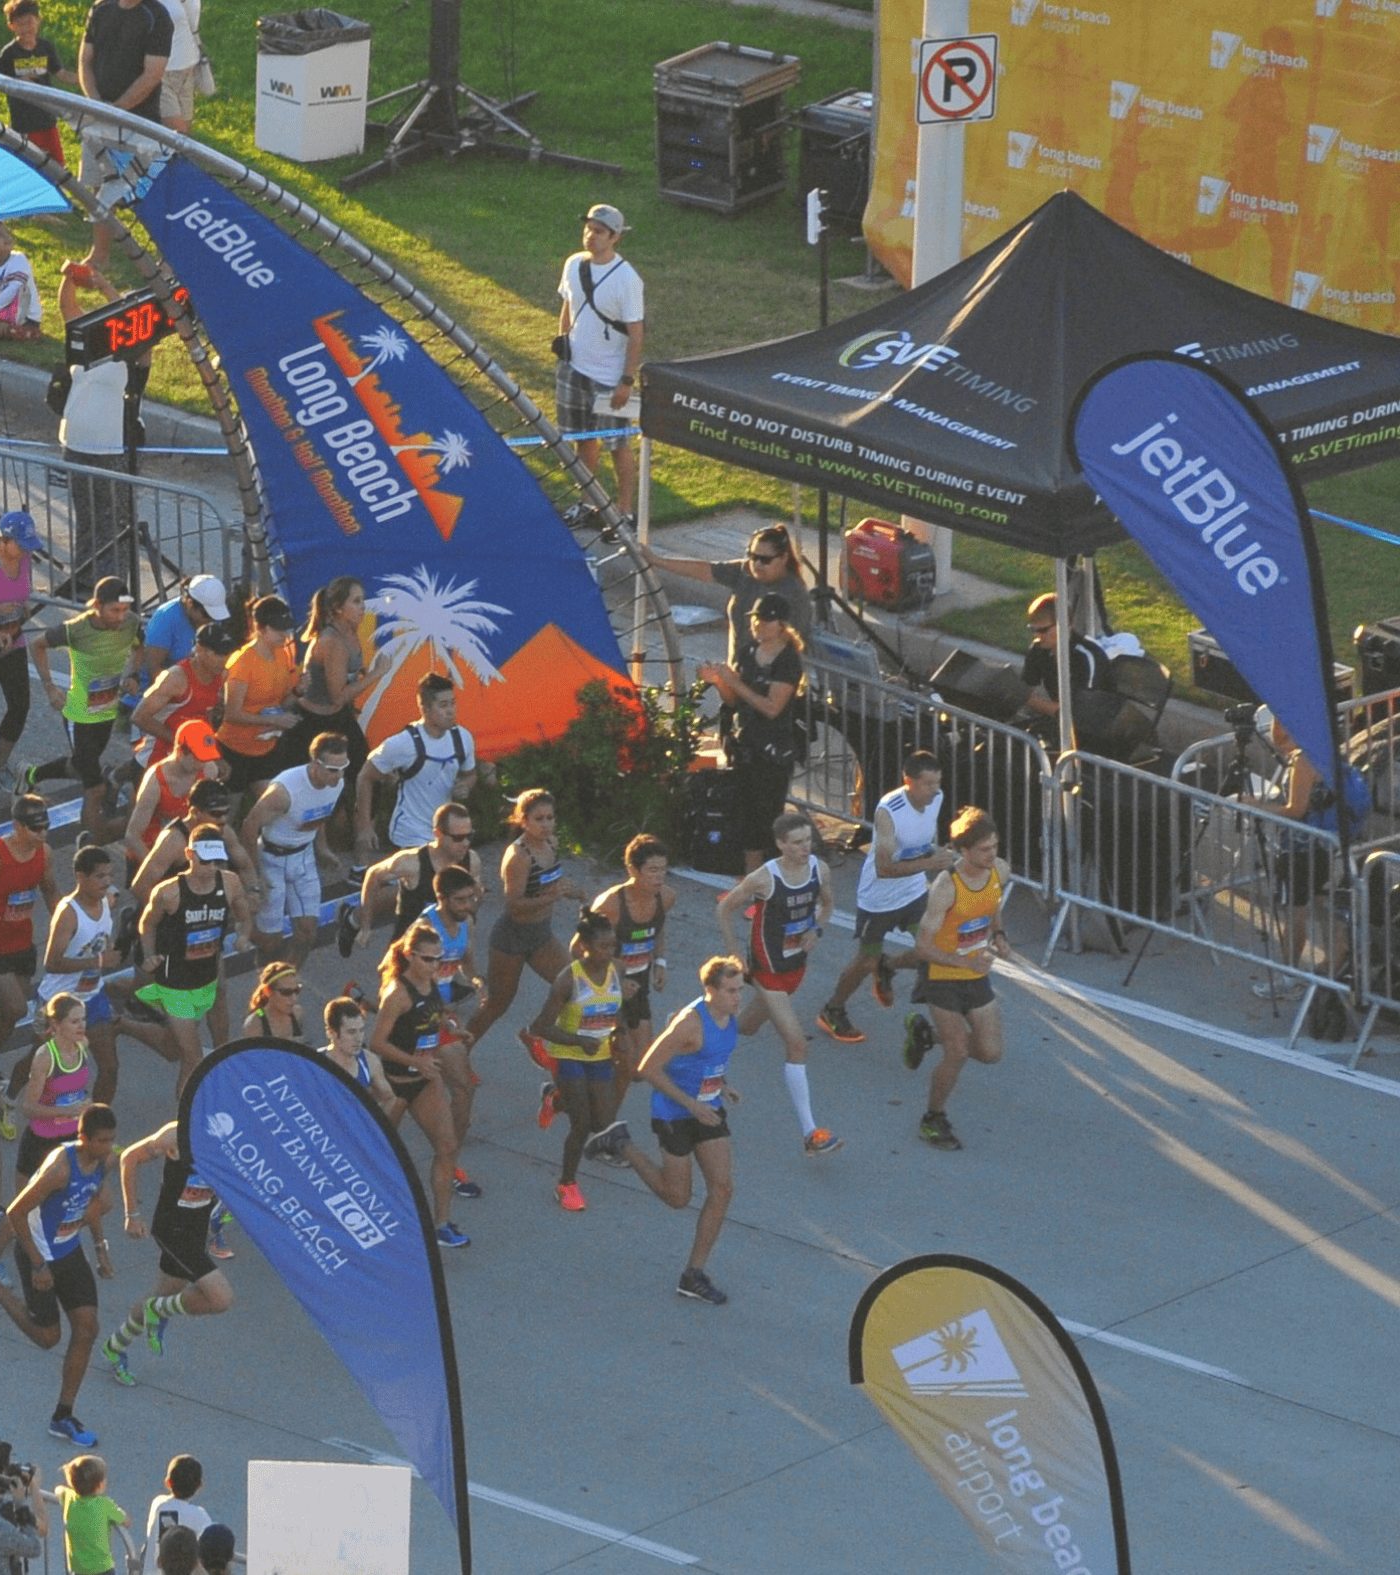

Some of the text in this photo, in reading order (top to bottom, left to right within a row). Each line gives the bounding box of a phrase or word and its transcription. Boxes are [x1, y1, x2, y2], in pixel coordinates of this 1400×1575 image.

[1042, 2, 1111, 26] long beach
[1242, 43, 1308, 69] long beach
[320, 84, 352, 99] WM
[1140, 94, 1203, 121] long beach
[1038, 143, 1102, 170] long beach
[1340, 138, 1362, 158] long
[964, 200, 1000, 220] beach
[1230, 190, 1299, 215] long beach
[165, 197, 275, 289] jetBlue
[1322, 286, 1396, 305] long beach
[1245, 361, 1361, 397] MANAGEMENT
[278, 342, 419, 524] Long Beach
[771, 372, 828, 389] EVENT
[824, 380, 881, 401] TIMING
[892, 397, 1018, 452] MANAGEMENT
[1290, 415, 1349, 442] TIMING
[672, 392, 1027, 506] PLEASE DO NOT DISTURB TIMING DURING EVENT
[689, 418, 1010, 525] Find results at www.SVETiming.com
[1110, 412, 1280, 596] jetBlue
[221, 1143, 265, 1196] CONVENTION
[241, 1084, 380, 1244] CITY BANK ICB
[265, 1074, 400, 1237] INTERNATIONAL
[227, 1130, 348, 1270] LONG BEACH
[985, 1409, 1046, 1498] long
[945, 1431, 1023, 1545] airport
